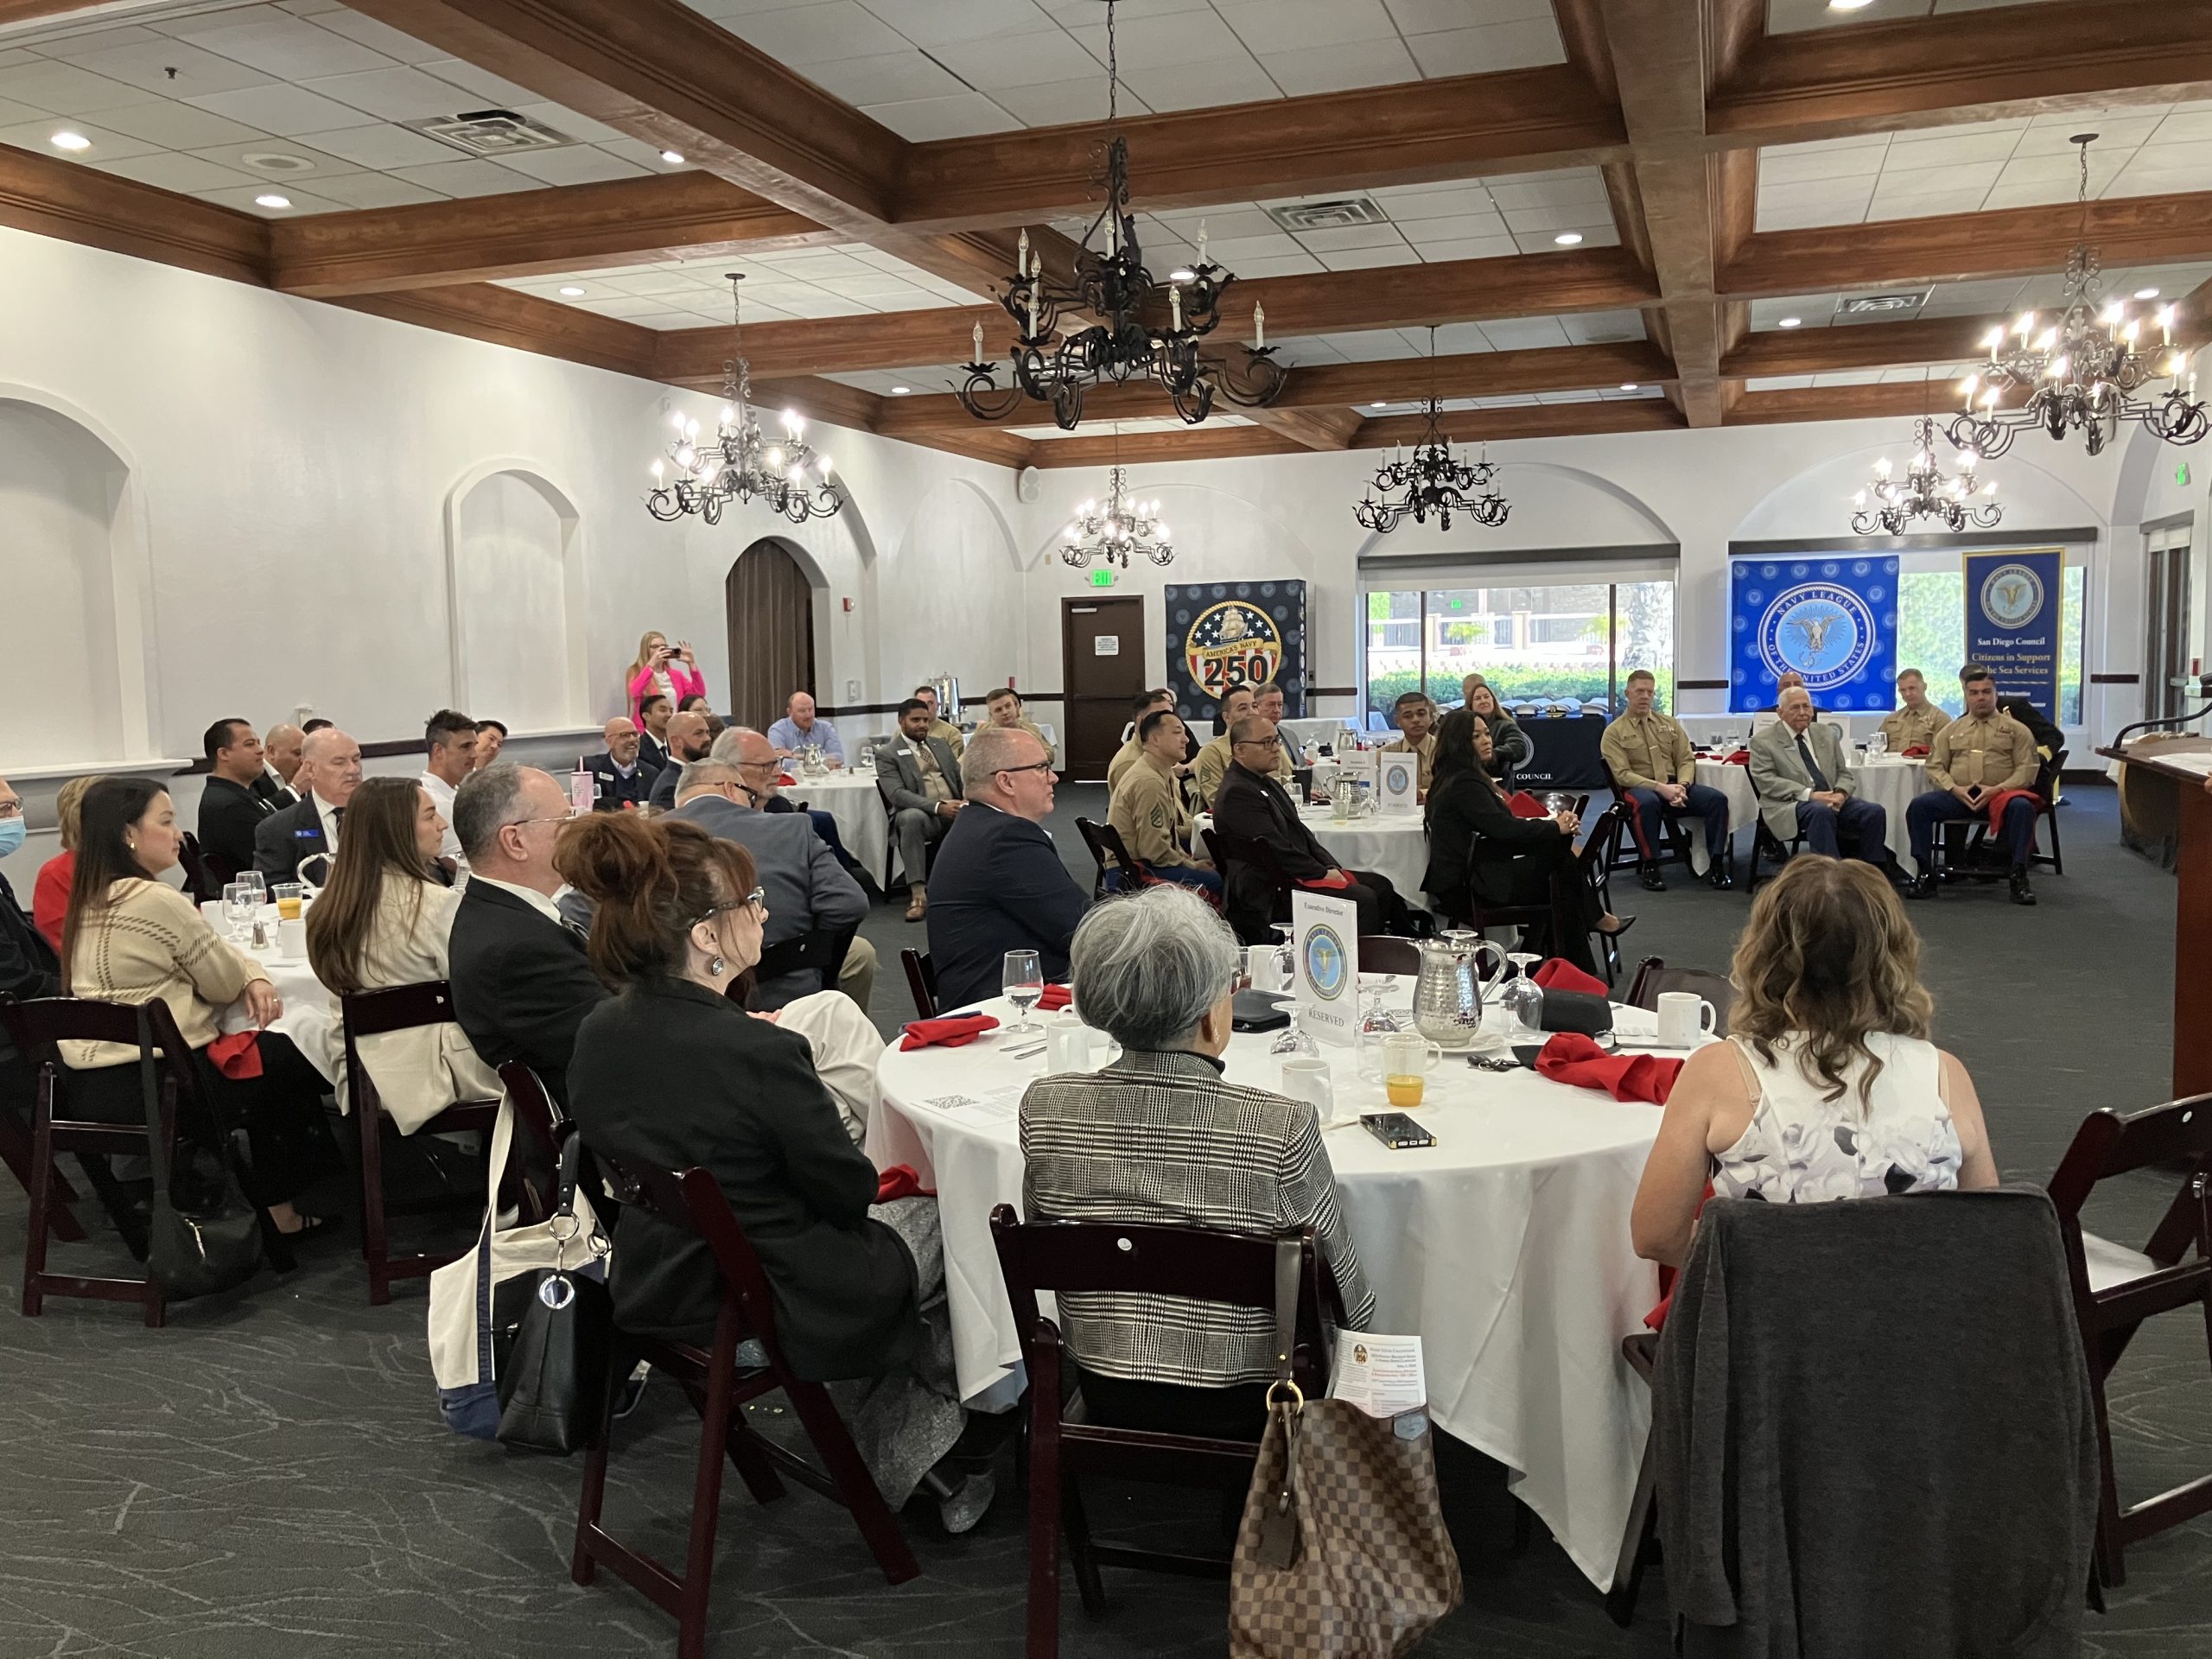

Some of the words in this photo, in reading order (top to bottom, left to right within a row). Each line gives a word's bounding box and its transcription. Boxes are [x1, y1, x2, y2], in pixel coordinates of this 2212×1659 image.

[1777, 594, 1805, 615] NAVY
[1812, 591, 1858, 614] LEAGUE
[1205, 645, 1238, 658] AMERICA'S
[1239, 640, 1257, 649] NAVY
[1977, 638, 1991, 646] San
[1993, 638, 2014, 648] Diego
[2015, 637, 2046, 645] Council
[1768, 644, 1778, 656] OF
[1802, 672, 1836, 683] NITED
[1837, 642, 1865, 675] STATES
[1972, 653, 2005, 662] Citizens
[2006, 653, 2015, 662] in
[2017, 652, 2051, 664] Support
[1204, 655, 1268, 687] 250
[1986, 665, 1997, 674] he
[1999, 665, 2012, 674] Sea
[2014, 665, 2049, 674] Services
[1308, 1008, 1344, 1027] RESERVED
